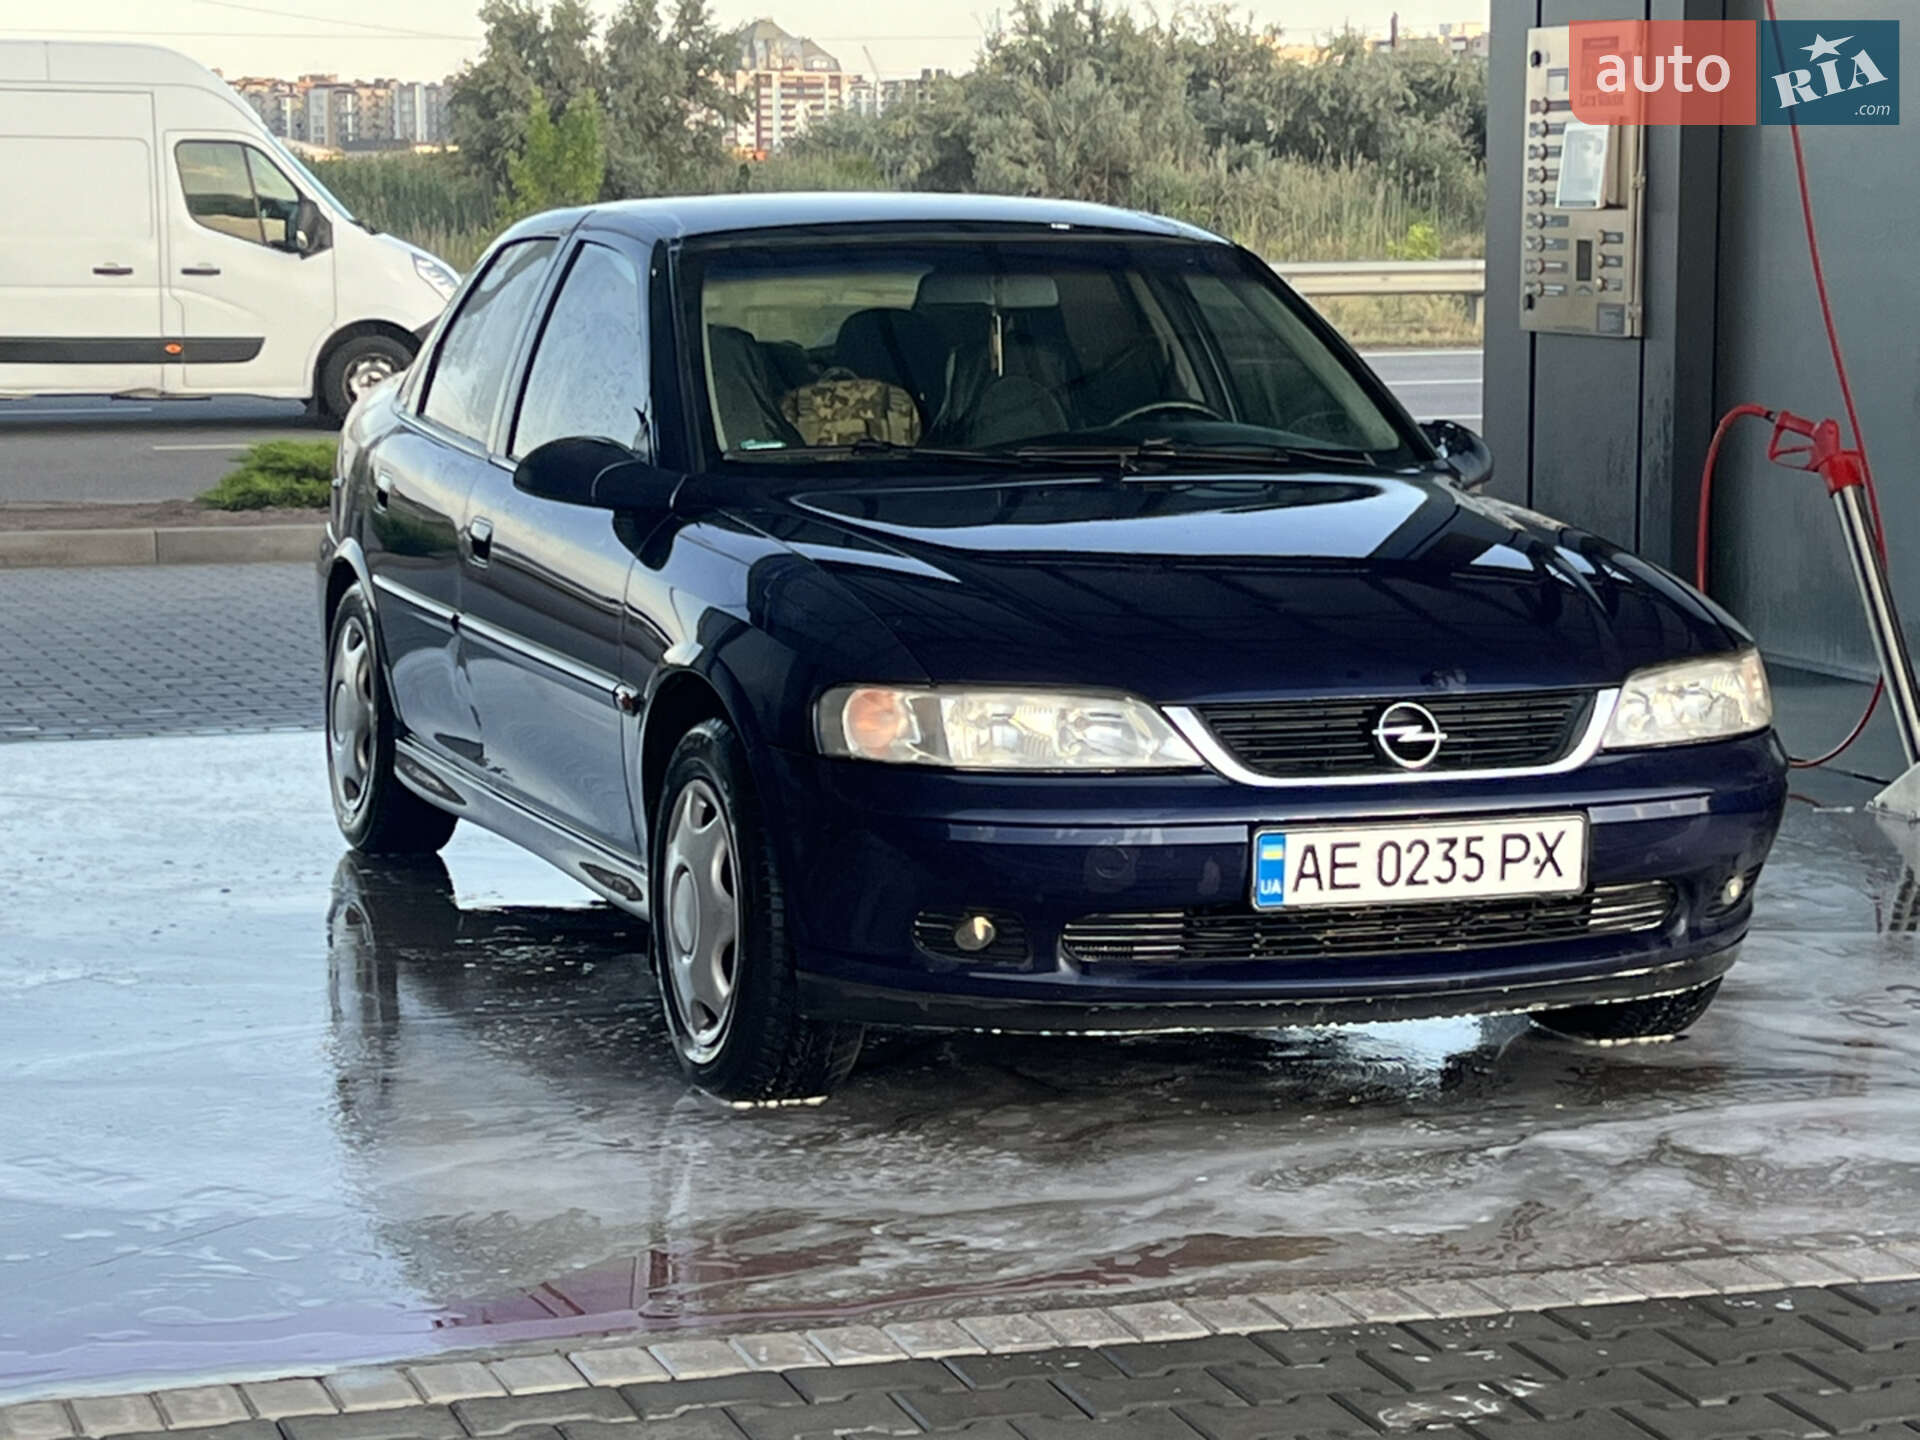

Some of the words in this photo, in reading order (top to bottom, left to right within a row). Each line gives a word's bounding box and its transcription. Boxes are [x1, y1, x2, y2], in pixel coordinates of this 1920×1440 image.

[1292, 842, 1361, 892] AE
[1377, 836, 1485, 888] 0235
[1499, 830, 1566, 881] PX
[1260, 879, 1282, 896] UA
